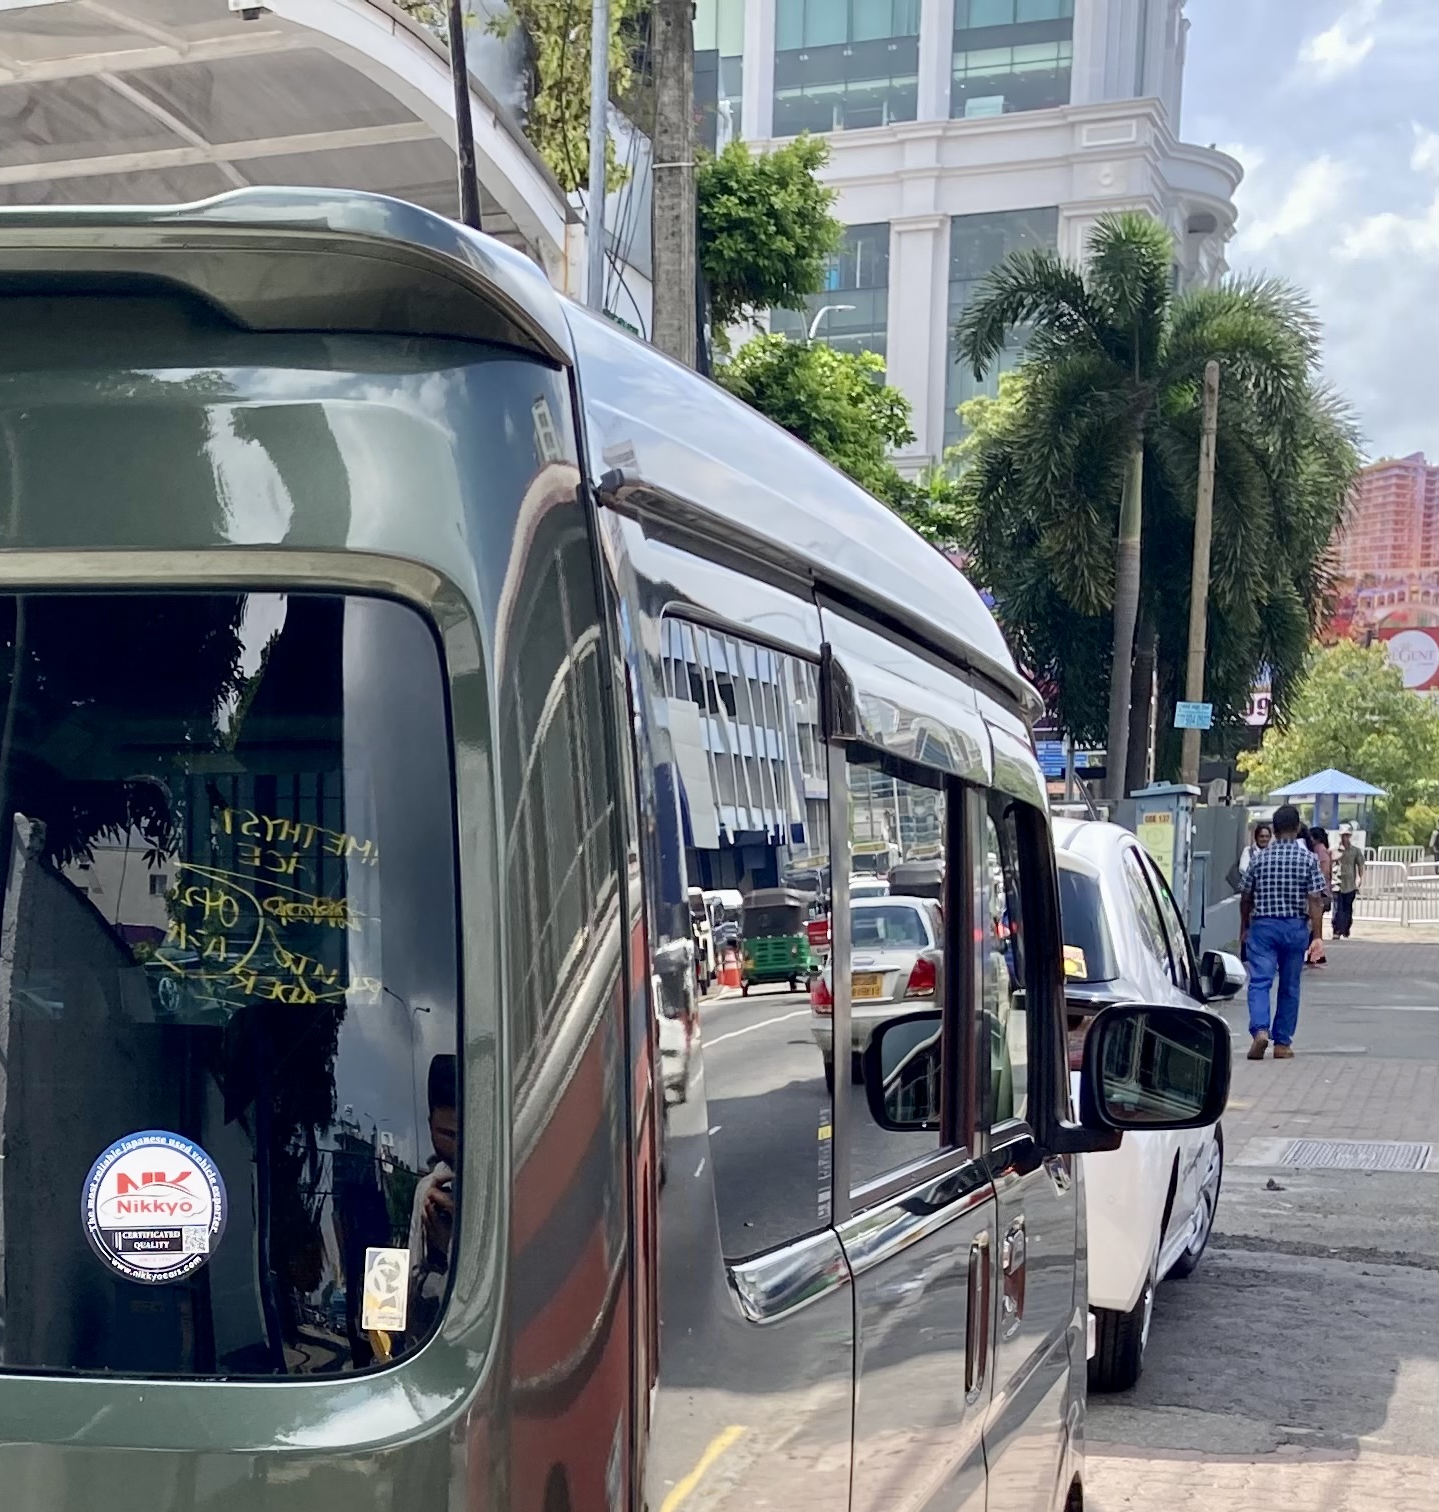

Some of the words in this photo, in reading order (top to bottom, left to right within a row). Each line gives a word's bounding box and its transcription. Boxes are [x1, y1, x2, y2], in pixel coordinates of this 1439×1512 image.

[92, 1147, 123, 1183] reliable
[168, 1137, 193, 1153] used
[191, 1150, 217, 1184] vehicle
[210, 1185, 222, 1234] exporter
[116, 1198, 193, 1217] Nikkyo
[121, 1230, 181, 1240] CERTIFICATED
[133, 1240, 170, 1251] QUALITY
[110, 1255, 203, 1283] www.nikkyocars.com
